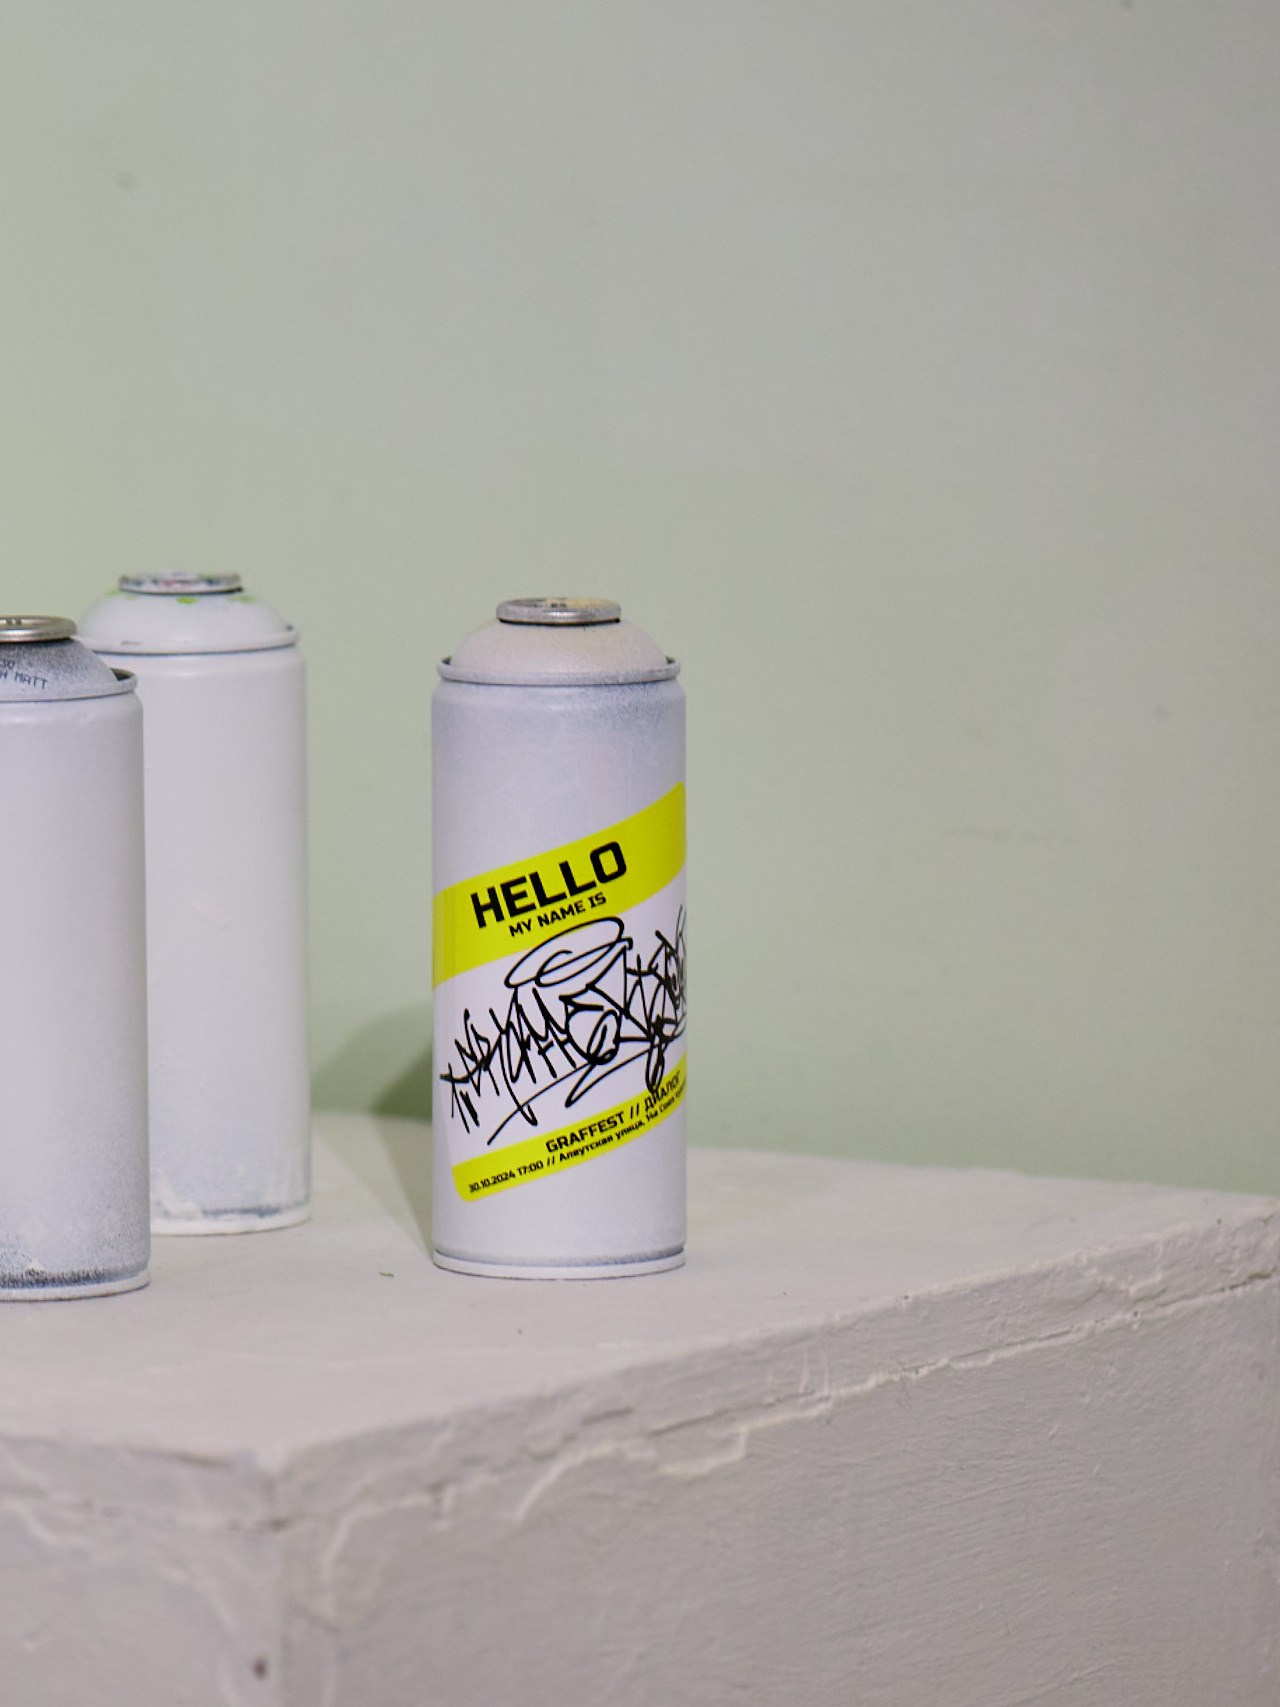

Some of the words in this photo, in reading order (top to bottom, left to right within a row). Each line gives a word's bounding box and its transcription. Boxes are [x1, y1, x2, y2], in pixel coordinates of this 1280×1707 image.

[14, 671, 48, 689] MATT
[470, 841, 627, 928] HELLO
[508, 919, 532, 937] MY
[537, 900, 586, 927] NAME
[588, 892, 607, 909] IS
[545, 1111, 625, 1153] GRAFFEST
[468, 1170, 515, 1193] 30.10.2024
[517, 1160, 544, 1176] 17:00
[559, 1135, 613, 1161] Алеутская
